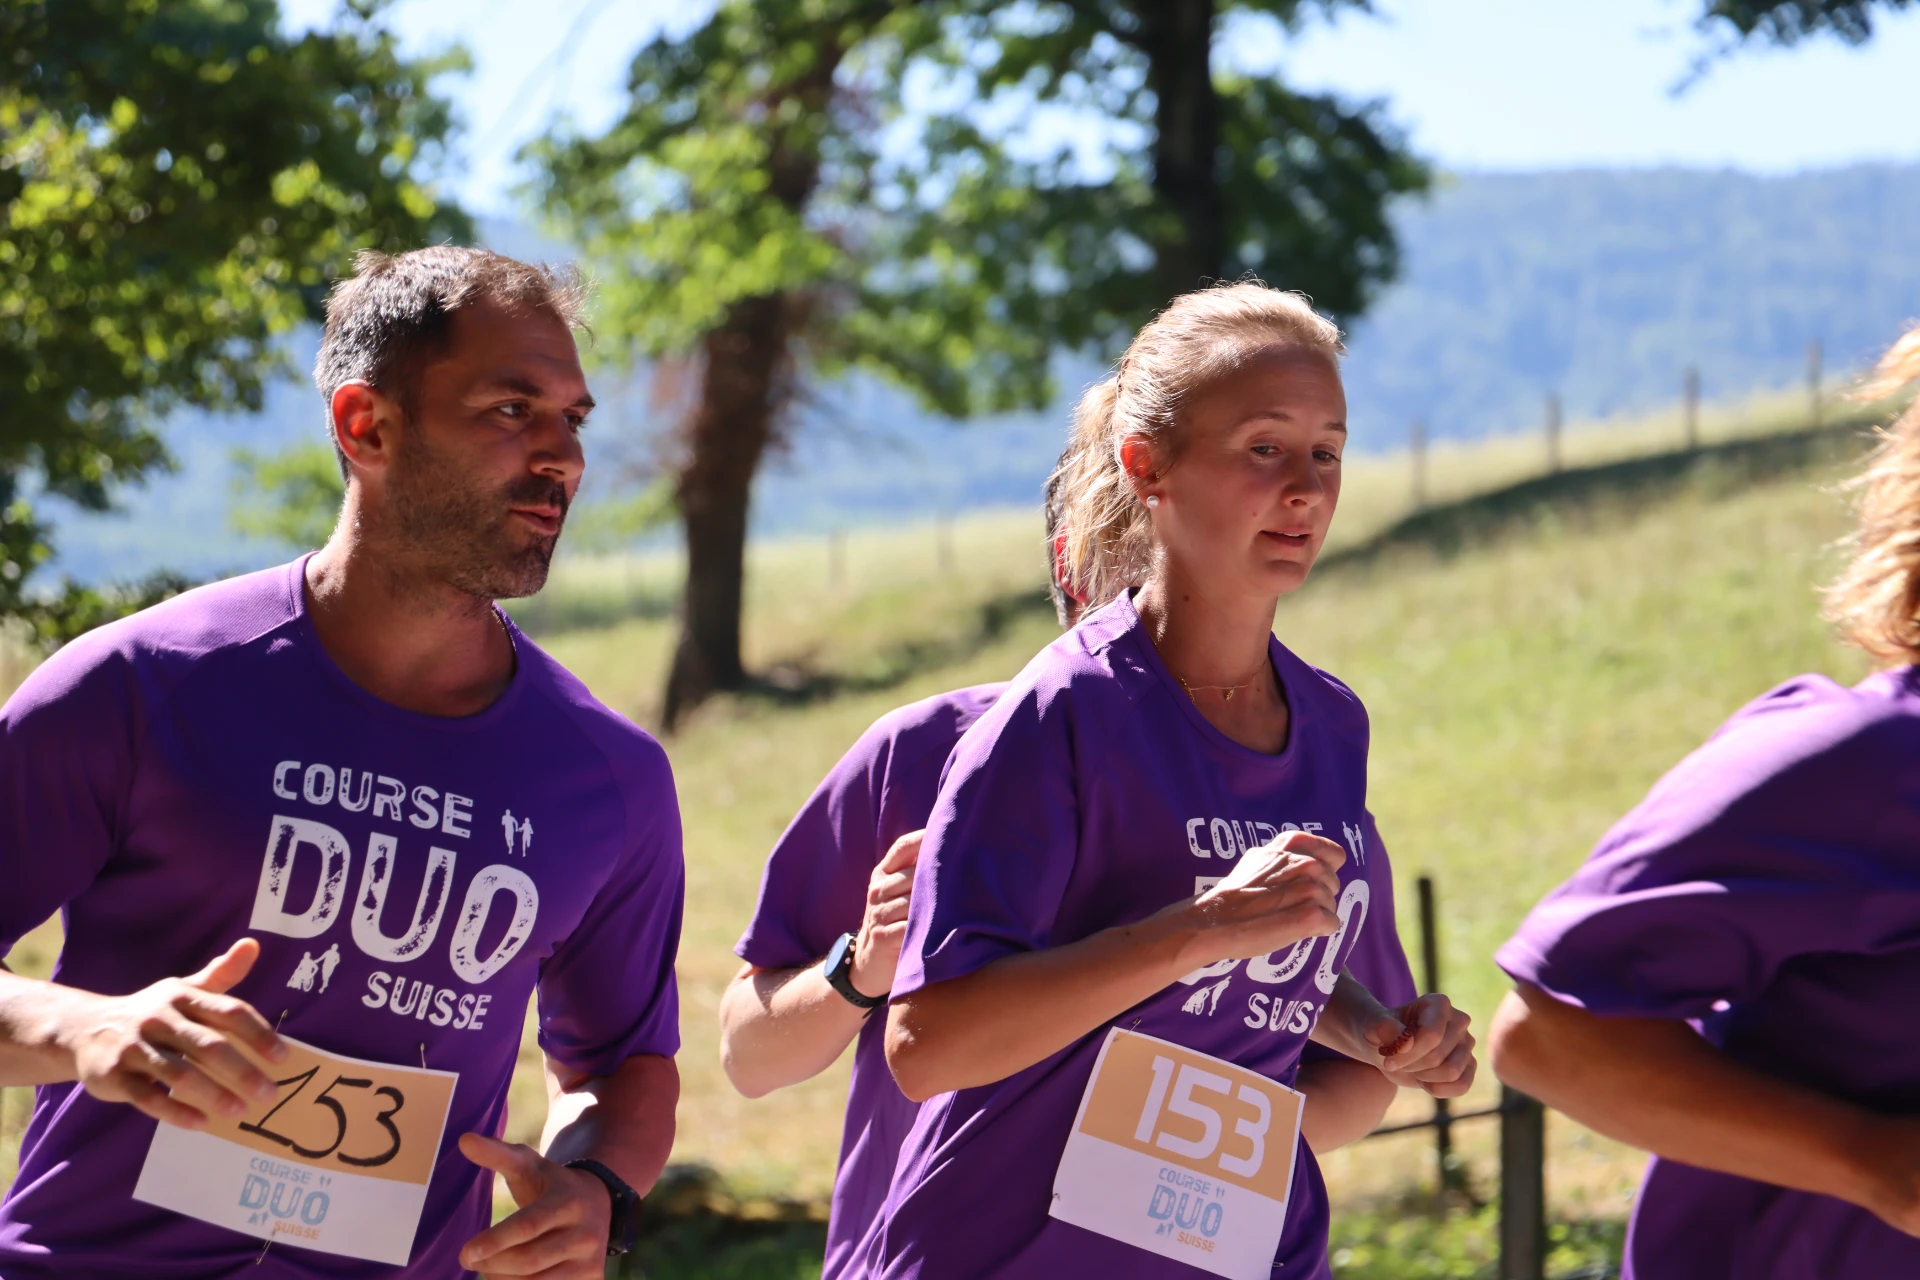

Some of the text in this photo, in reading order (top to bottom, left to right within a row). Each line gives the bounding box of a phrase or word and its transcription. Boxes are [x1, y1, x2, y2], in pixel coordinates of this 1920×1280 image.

[273, 761, 473, 838] COURSE
[249, 814, 539, 984] DUO
[361, 971, 492, 1030] SUISSE
[238, 1065, 405, 1168] 153
[1134, 1055, 1272, 1178] 153
[249, 1157, 312, 1185] COURSE
[1159, 1167, 1211, 1196] COURSE
[238, 1173, 330, 1225] DUO
[1147, 1183, 1223, 1237] DUO
[273, 1220, 321, 1240] SUISSE
[1177, 1231, 1216, 1253] SUISSE
